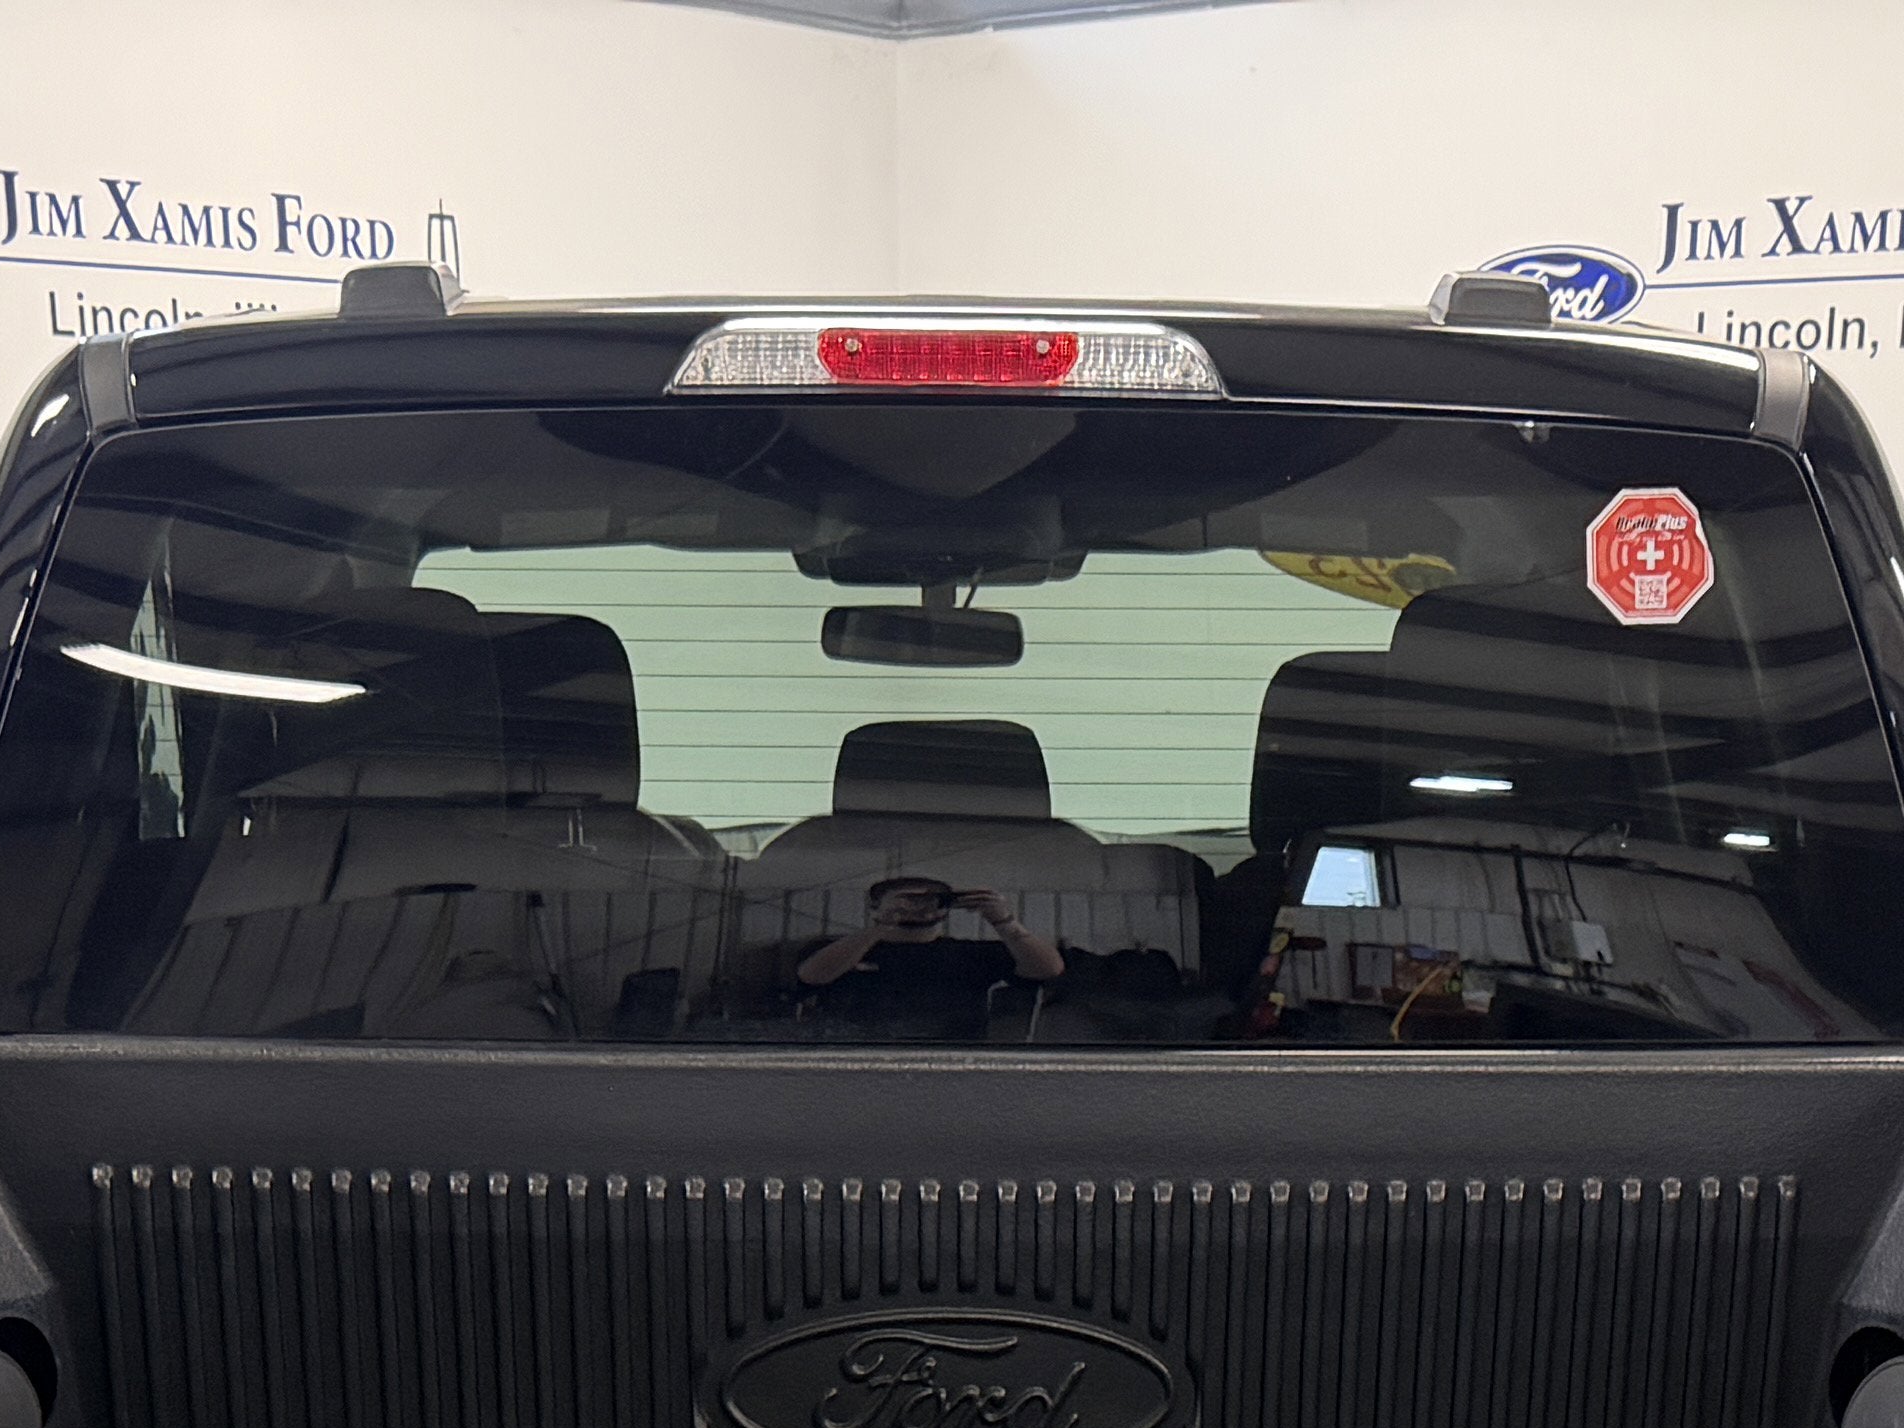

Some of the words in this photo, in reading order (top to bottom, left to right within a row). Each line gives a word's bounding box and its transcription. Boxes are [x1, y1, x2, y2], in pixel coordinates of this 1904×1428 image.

[99, 178, 257, 251] XAMIS
[271, 192, 395, 260] FORD
[1656, 202, 1746, 274] JIM
[49, 290, 204, 337] Lincol
